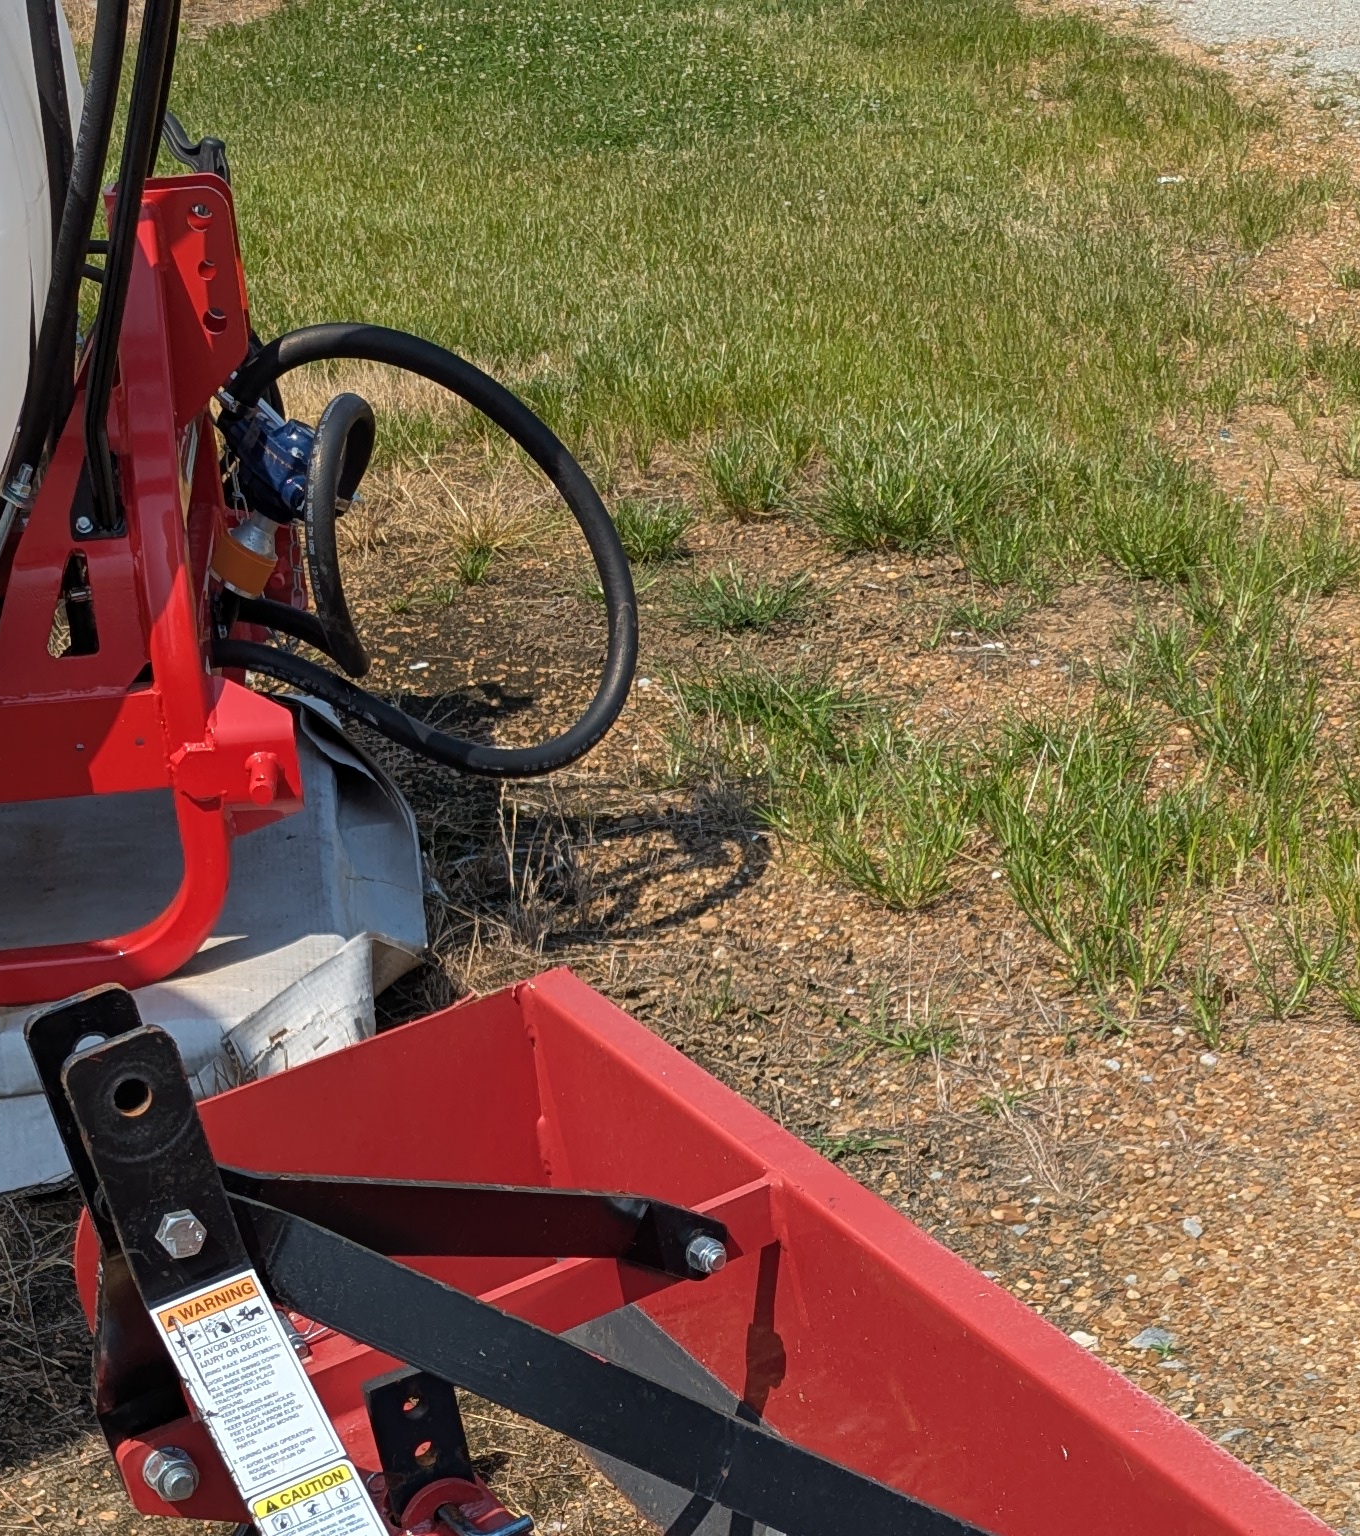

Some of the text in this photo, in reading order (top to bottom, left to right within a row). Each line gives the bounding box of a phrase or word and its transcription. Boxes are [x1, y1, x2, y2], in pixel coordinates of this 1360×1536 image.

[177, 1281, 254, 1320] WARNING
[201, 1340, 229, 1355] AVOID
[229, 1324, 267, 1344] SERIOUS
[225, 1347, 239, 1357] OR
[239, 1334, 271, 1351] DEATH:
[278, 1469, 344, 1505] CAUTION
